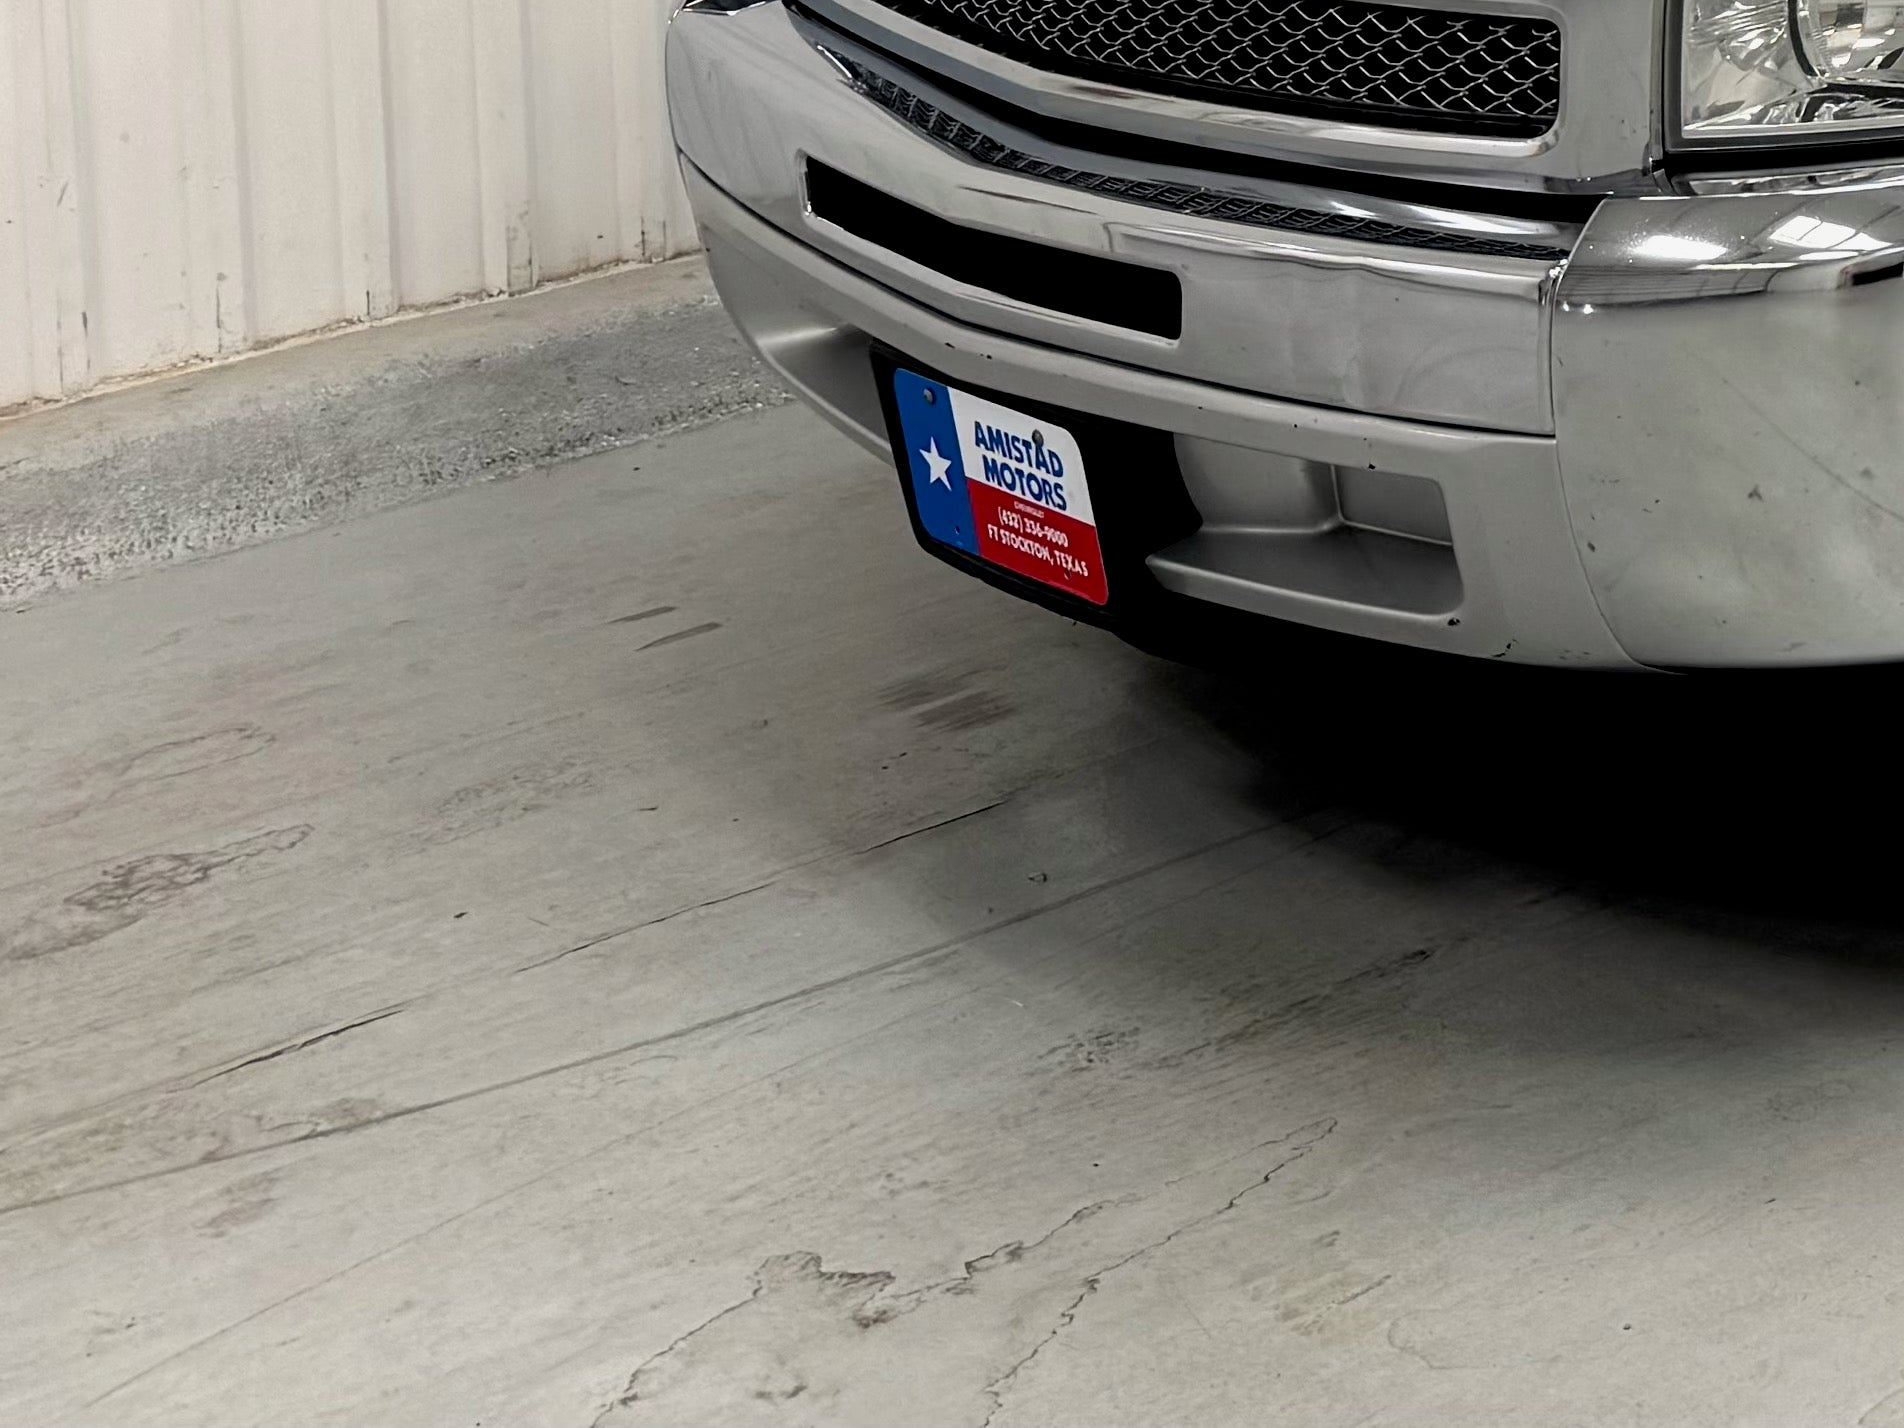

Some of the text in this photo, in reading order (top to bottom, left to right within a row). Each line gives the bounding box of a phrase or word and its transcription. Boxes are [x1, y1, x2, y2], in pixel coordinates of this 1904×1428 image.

[974, 420, 1064, 478] AMISTAD
[982, 455, 1067, 511] MOTORS
[997, 506, 1024, 534] (432)
[987, 523, 1089, 577] FT STOCKTON, TEXAS
